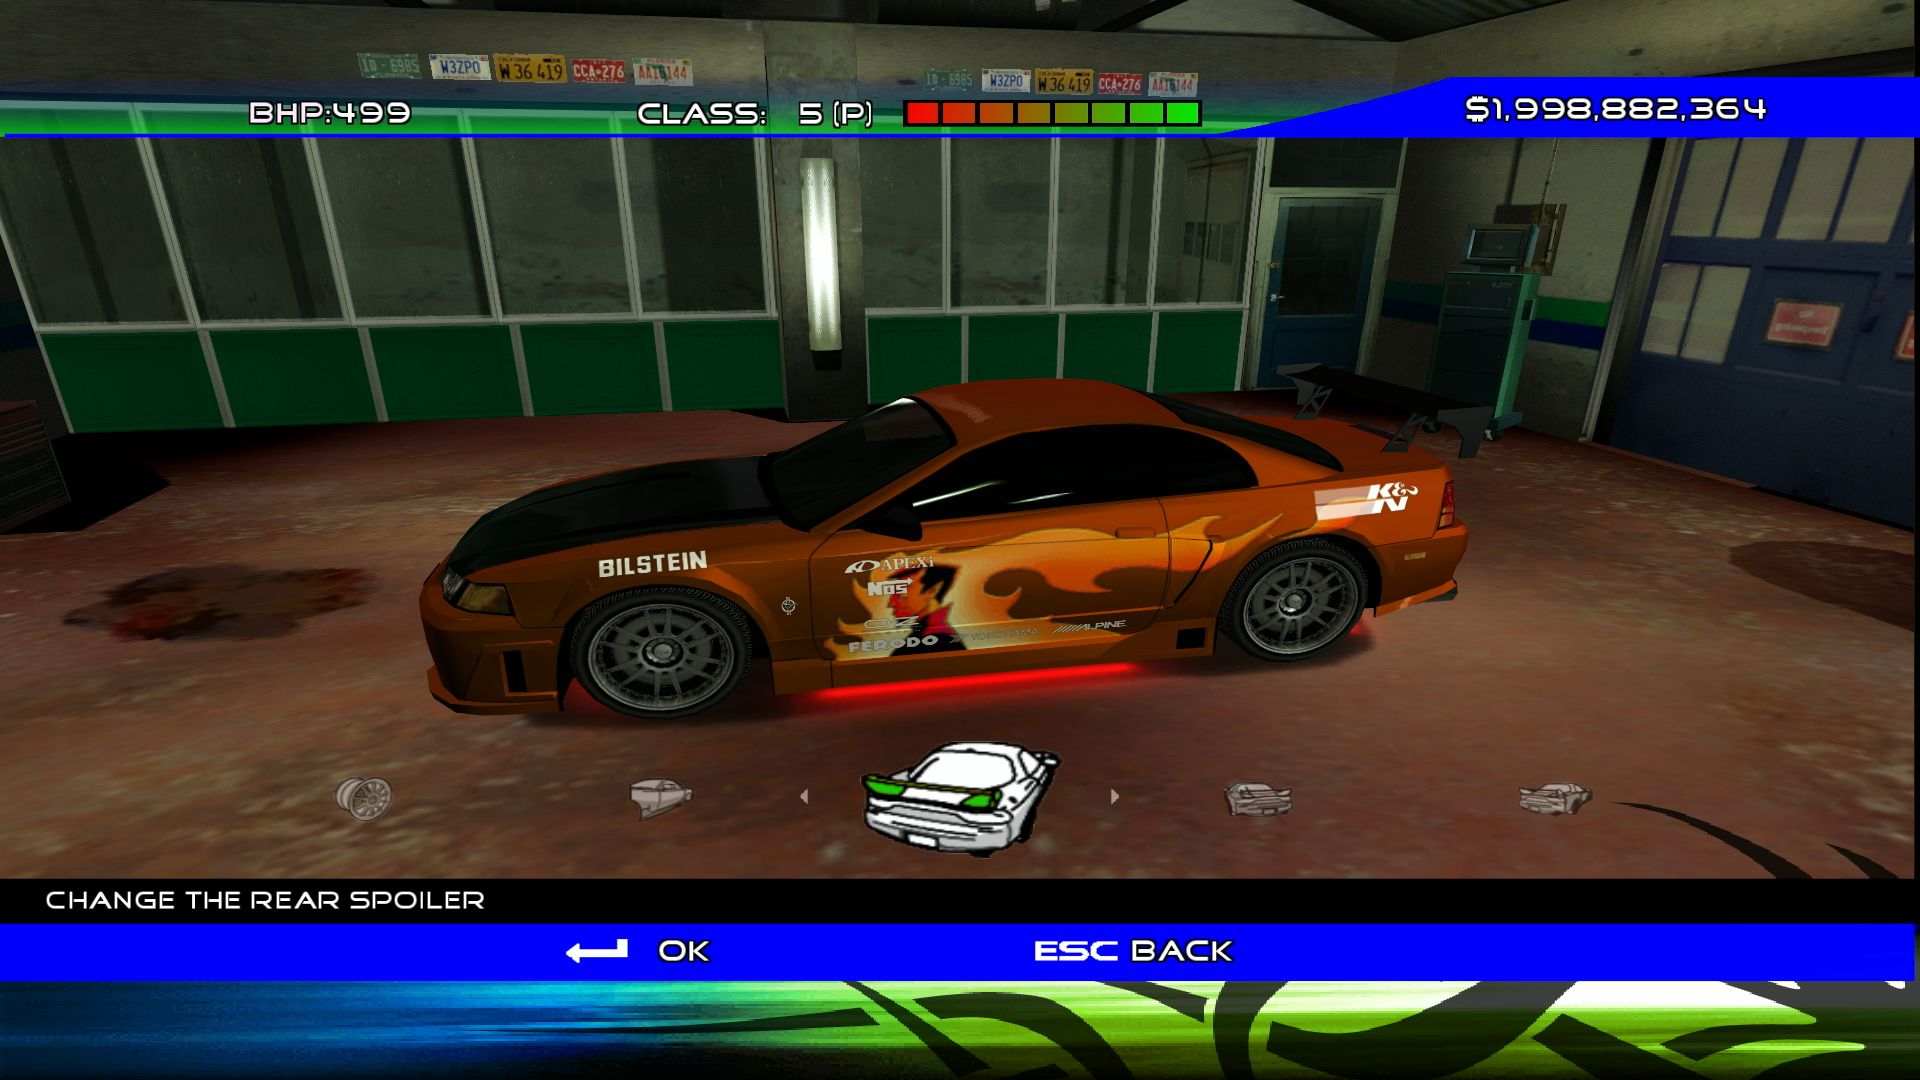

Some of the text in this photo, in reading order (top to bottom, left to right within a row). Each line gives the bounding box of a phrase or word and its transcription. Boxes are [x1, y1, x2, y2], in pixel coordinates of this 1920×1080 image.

[513, 63, 532, 80] 36
[537, 64, 562, 81] 419
[598, 550, 708, 578] BILSTEIN
[1080, 620, 1127, 632] ALPINE
[848, 634, 939, 653] FERODO
